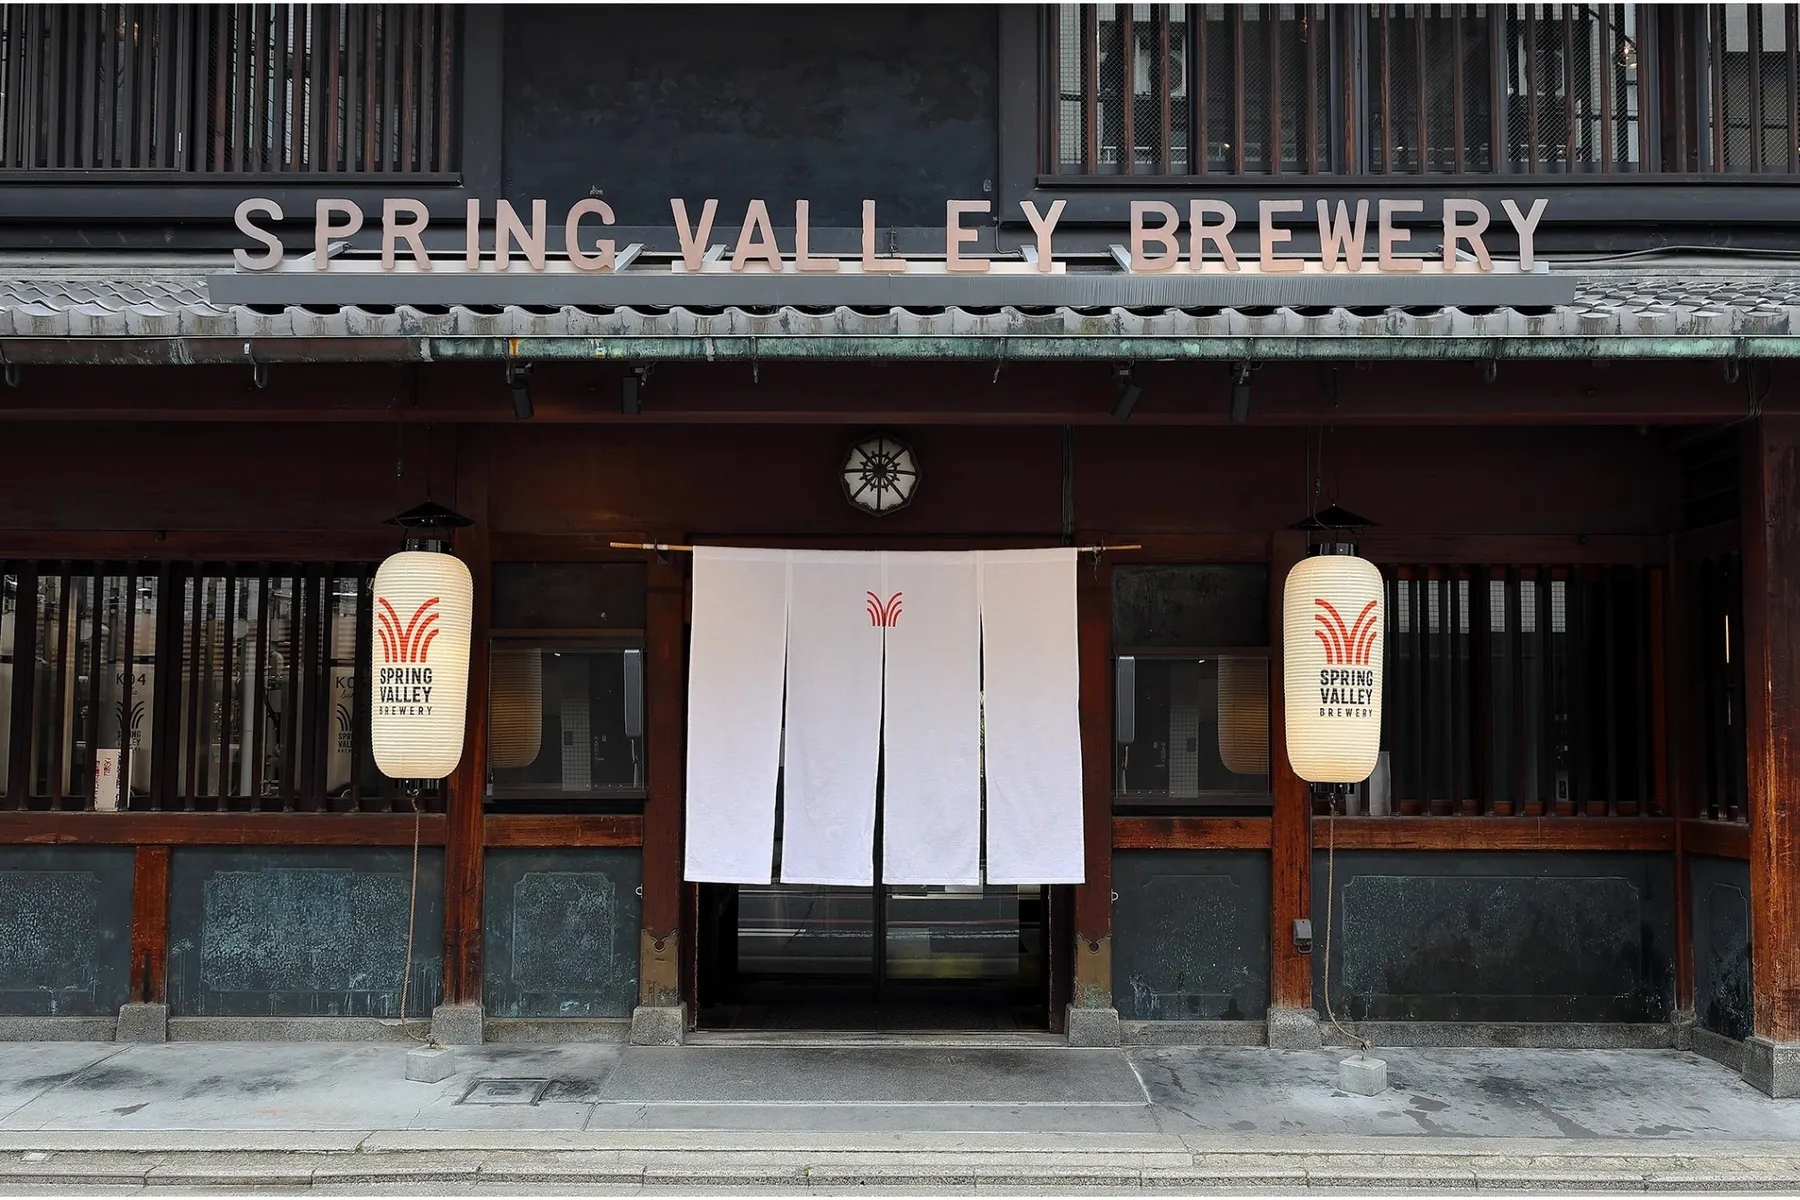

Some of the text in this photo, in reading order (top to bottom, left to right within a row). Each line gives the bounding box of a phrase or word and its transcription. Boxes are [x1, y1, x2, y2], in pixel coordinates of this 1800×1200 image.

[233, 197, 1550, 273] SPRING VALLEY BREWERY
[380, 667, 433, 685] SPRING
[1320, 669, 1373, 686] SPRING
[380, 686, 432, 704] VALLEY
[1320, 687, 1373, 705] VALLEY
[379, 706, 433, 715] BREWERY
[1320, 708, 1373, 717] BREWERY
